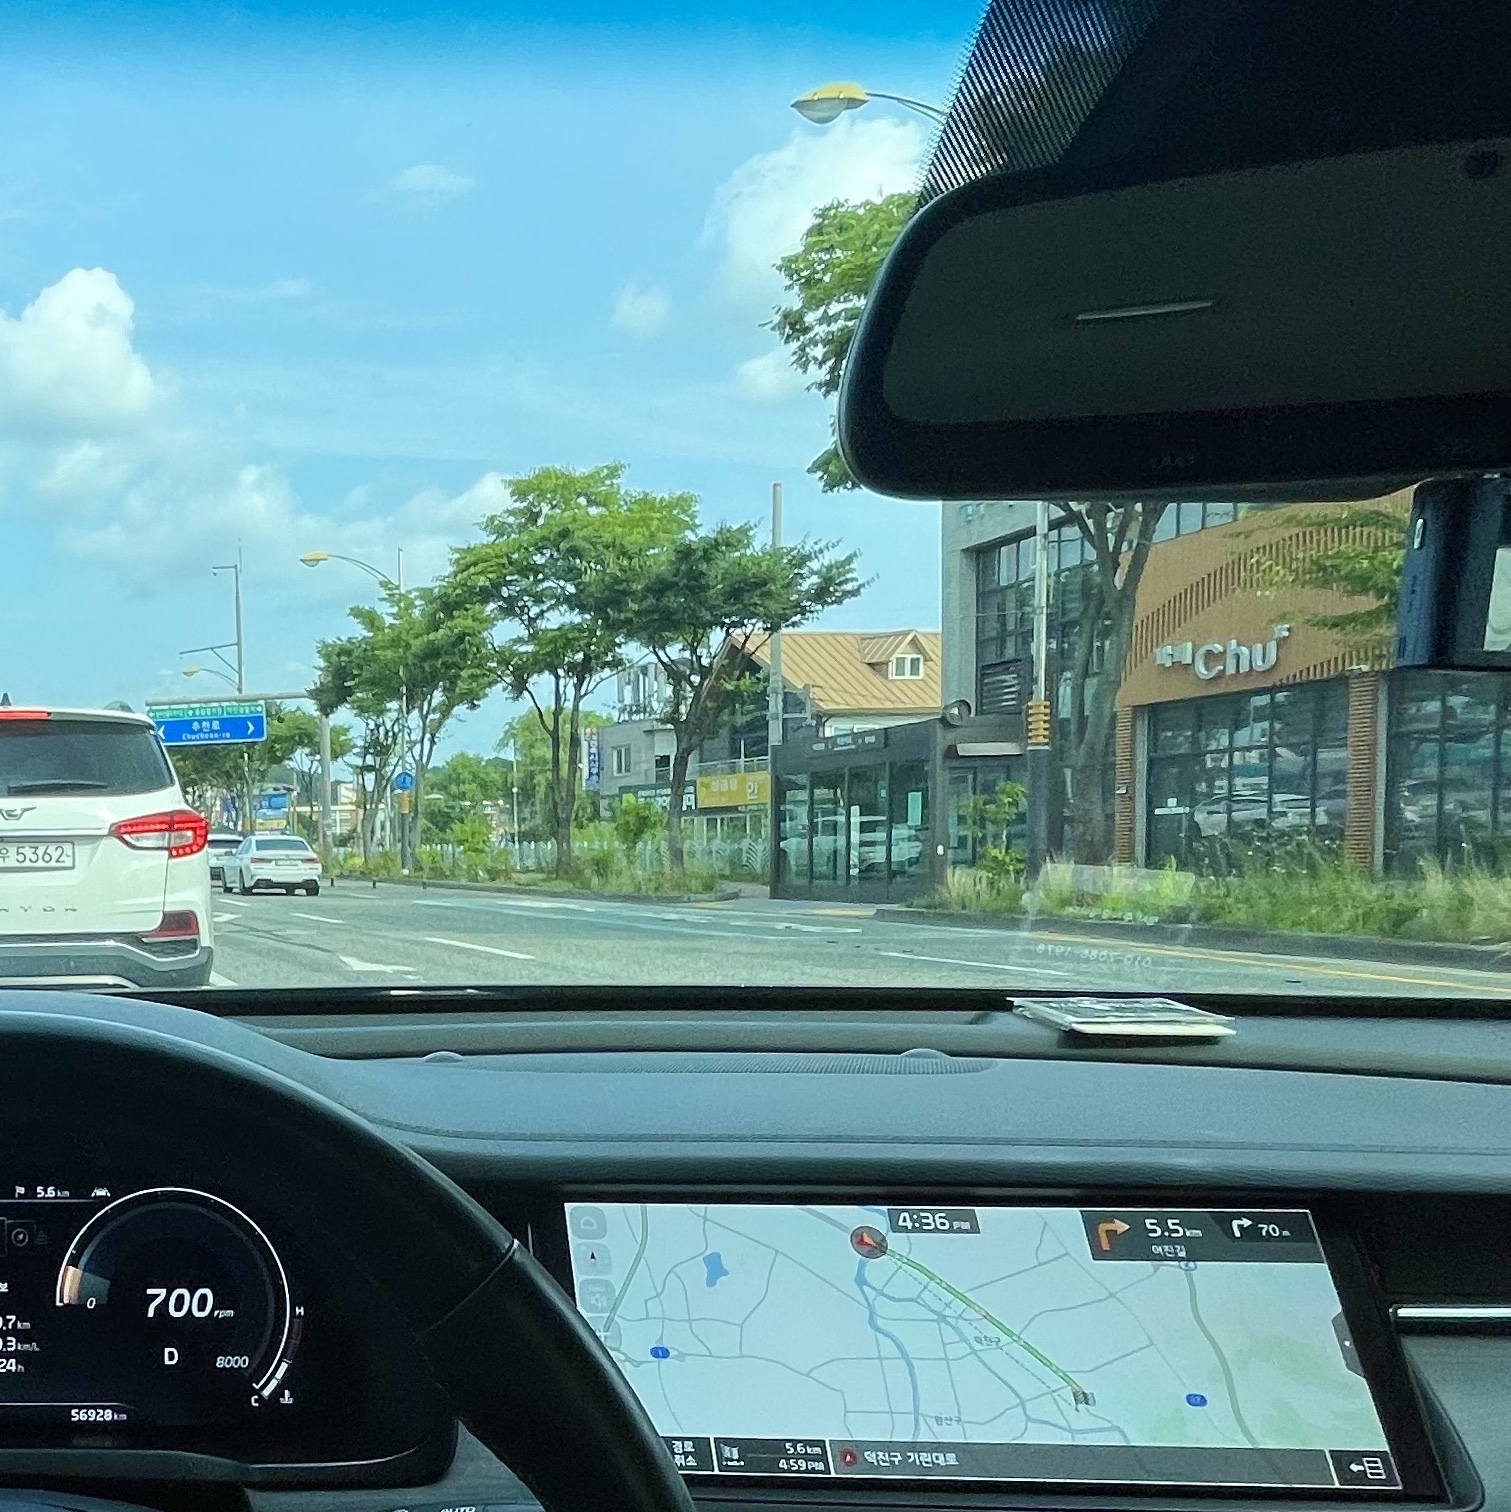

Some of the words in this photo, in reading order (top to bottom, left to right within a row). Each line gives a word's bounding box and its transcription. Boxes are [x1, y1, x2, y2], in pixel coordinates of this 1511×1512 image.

[15, 845, 65, 864] 5362
[897, 1212, 950, 1231] 4:36
[146, 1287, 214, 1318] 700
[163, 1347, 179, 1366] D
[215, 1355, 250, 1369] 8000
[863, 1450, 903, 1466] 덕진구
[906, 1450, 960, 1467] 기린대로
